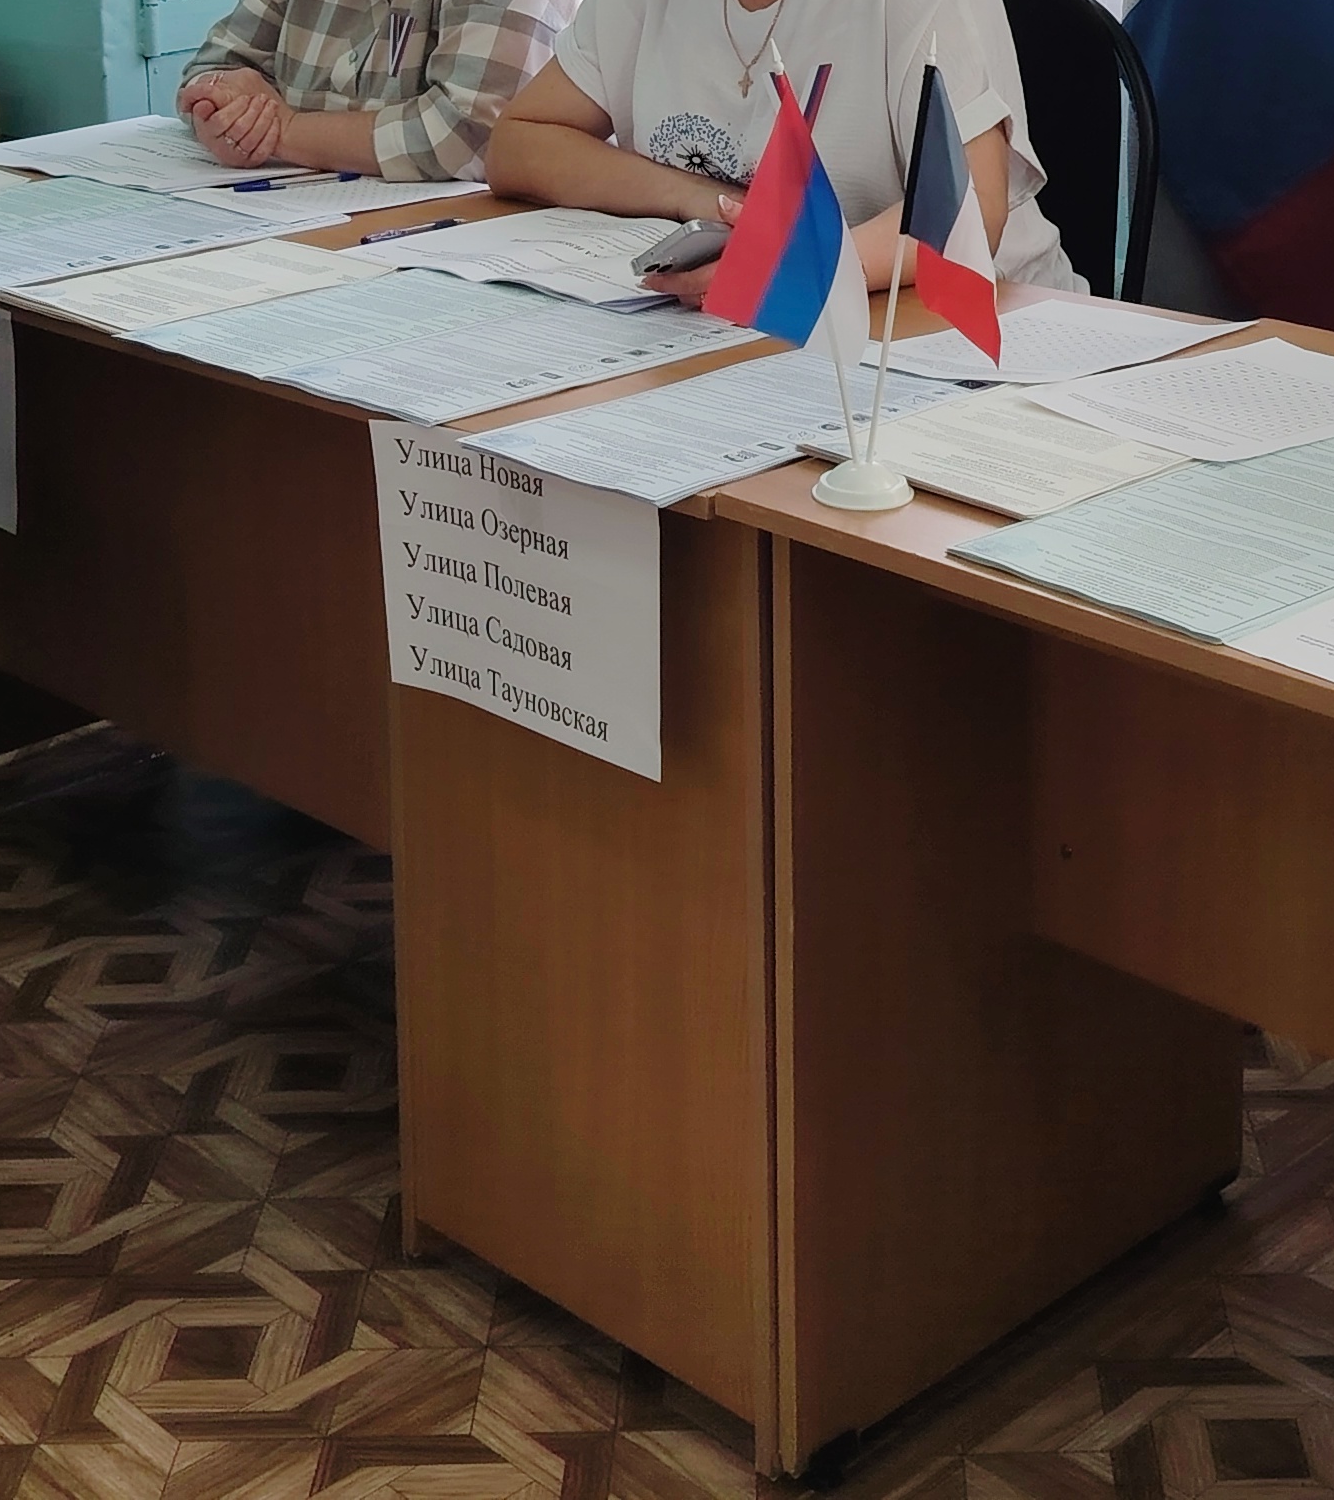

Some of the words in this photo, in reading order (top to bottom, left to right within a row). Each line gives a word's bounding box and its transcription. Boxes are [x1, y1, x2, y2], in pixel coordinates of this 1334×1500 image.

[394, 438, 472, 477] Улица
[479, 453, 543, 497] Новая
[399, 490, 474, 530] Улица
[481, 508, 569, 559] Озерная
[402, 541, 477, 583] Улица
[484, 561, 572, 616] Полевая
[406, 593, 479, 637] Улица
[486, 615, 572, 671] Садовая
[409, 645, 481, 690] Улица
[487, 668, 609, 742] Тауновская
